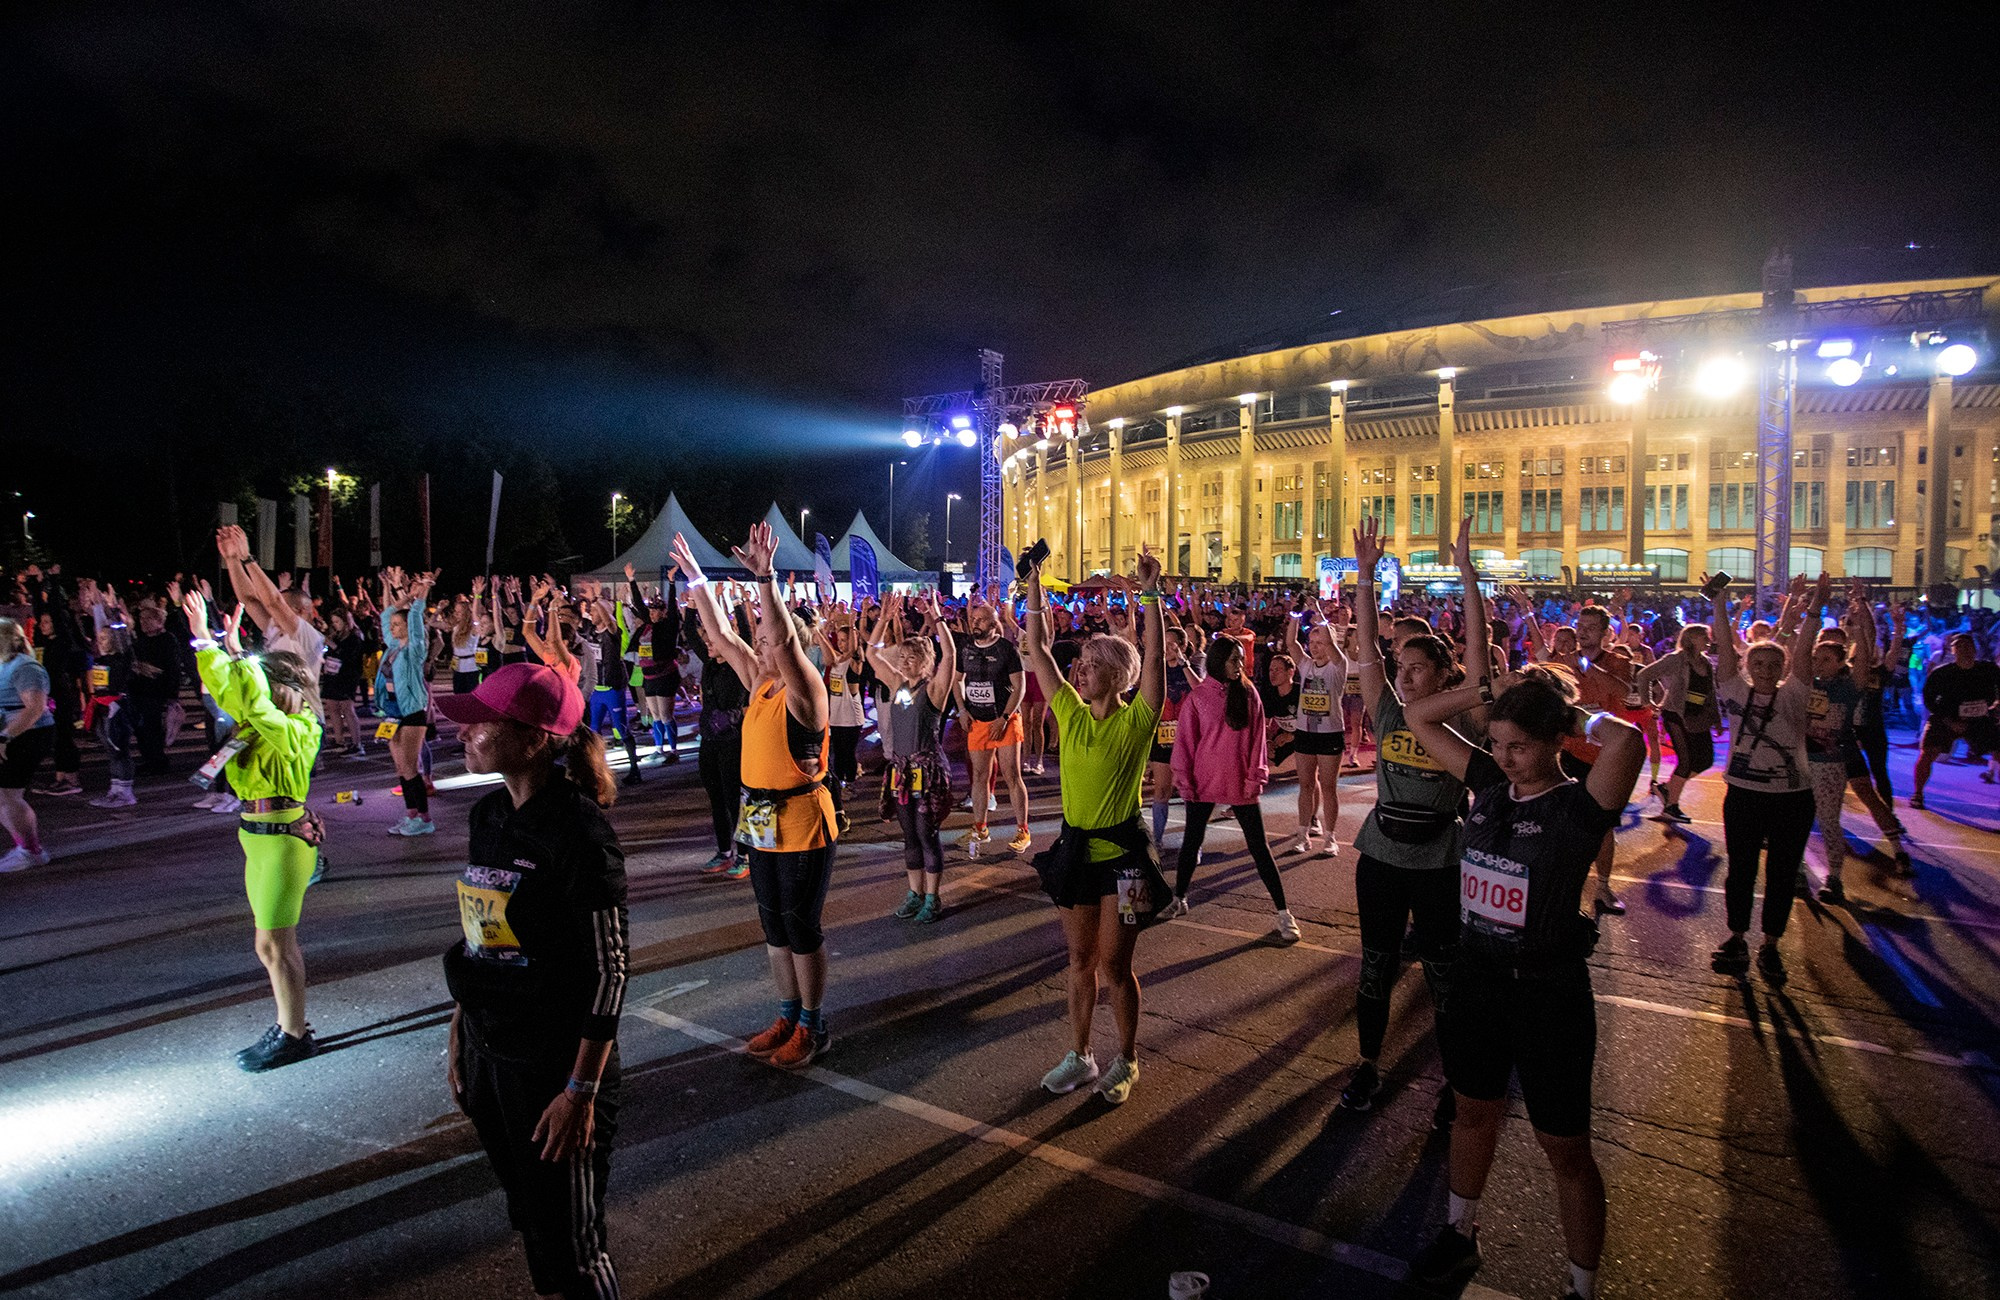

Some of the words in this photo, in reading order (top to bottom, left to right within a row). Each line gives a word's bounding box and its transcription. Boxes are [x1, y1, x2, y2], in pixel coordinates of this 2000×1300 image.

[970, 690, 990, 698] 4546
[1304, 697, 1326, 706] 8223
[1391, 735, 1431, 758] 518
[513, 858, 537, 870] adidas
[1463, 872, 1524, 913] 10108
[1127, 913, 1134, 923] G
